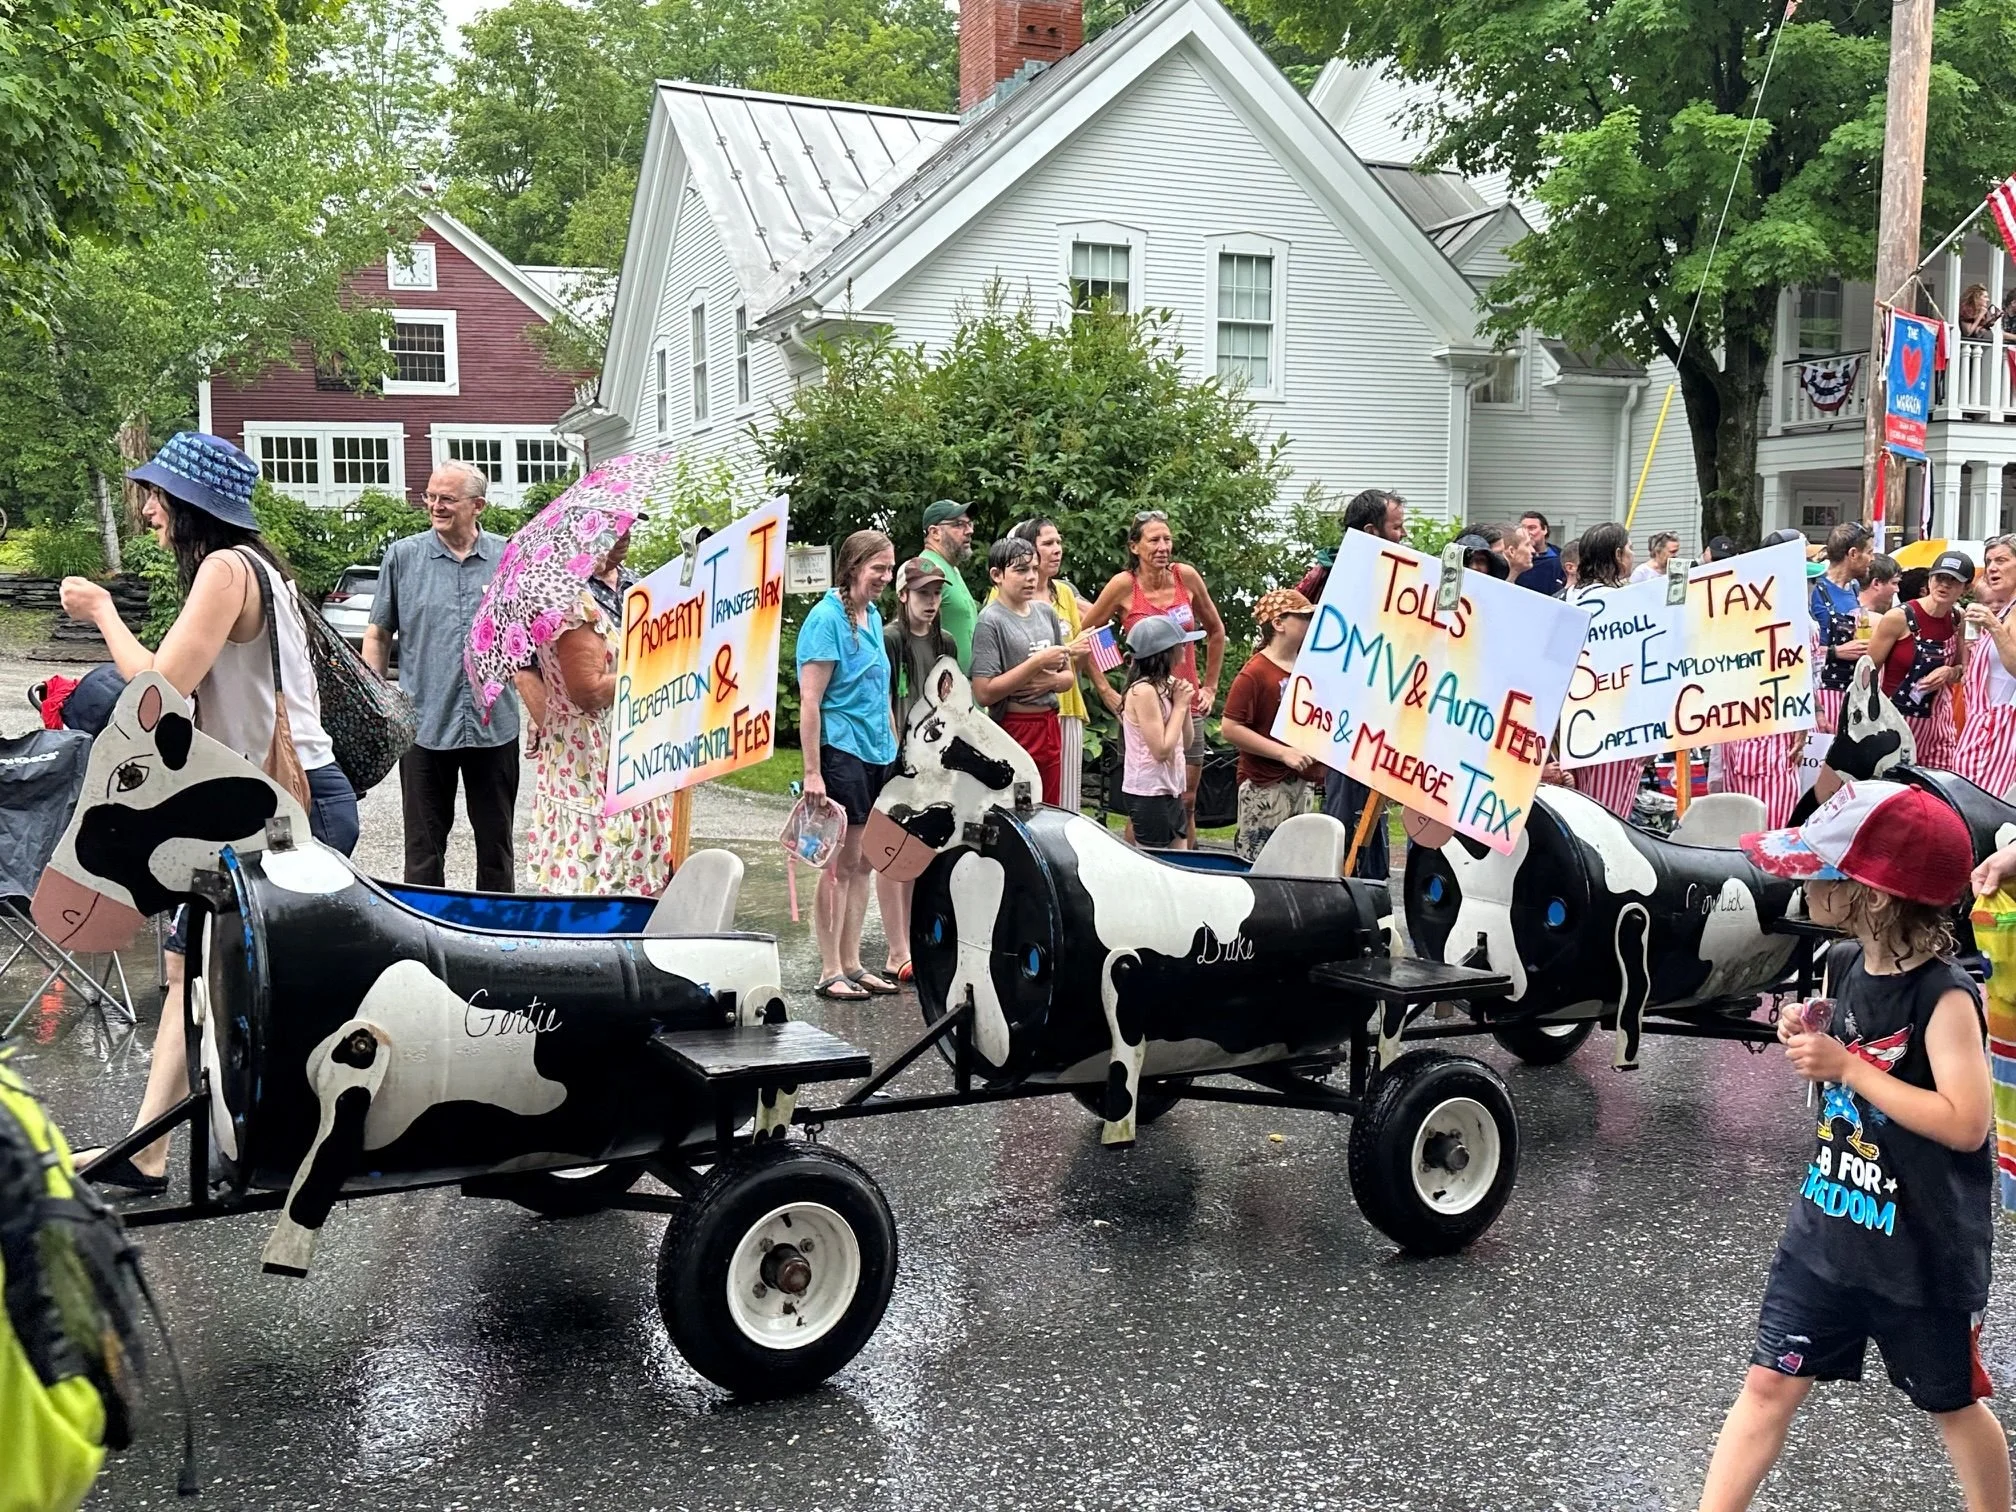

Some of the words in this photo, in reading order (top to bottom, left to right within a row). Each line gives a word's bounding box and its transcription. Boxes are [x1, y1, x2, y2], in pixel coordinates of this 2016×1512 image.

[1908, 326, 1919, 340] THE
[625, 590, 704, 661] PROPERTY
[704, 546, 760, 629] TRANSFER
[751, 520, 781, 610] TAX
[1381, 551, 1472, 639] TOLLS
[1689, 570, 1775, 619] TAX
[617, 665, 711, 731] RECREATION
[715, 644, 738, 703] &
[1310, 604, 1421, 705] DMV
[1404, 661, 1428, 709] &
[1428, 671, 1495, 743] AUTO
[1494, 689, 1547, 767] FEES
[1568, 650, 1634, 702] SELF
[1641, 629, 1766, 685] EMPLOYMENT
[1754, 621, 1804, 673] TAX
[616, 725, 734, 795] ENVIRONMENTAL
[733, 704, 770, 761] FEES
[1291, 676, 1333, 732] GAS
[1333, 710, 1354, 744] &
[1351, 722, 1454, 807] MILEAGE
[1457, 760, 1522, 842] TAX
[1566, 708, 1674, 760] CAPITAL
[1674, 683, 1775, 737] GAINS
[1759, 674, 1812, 721] TAX
[1197, 921, 1256, 965] Duke
[465, 988, 563, 1038] Gertie
[1838, 1151, 1882, 1195] FOR
